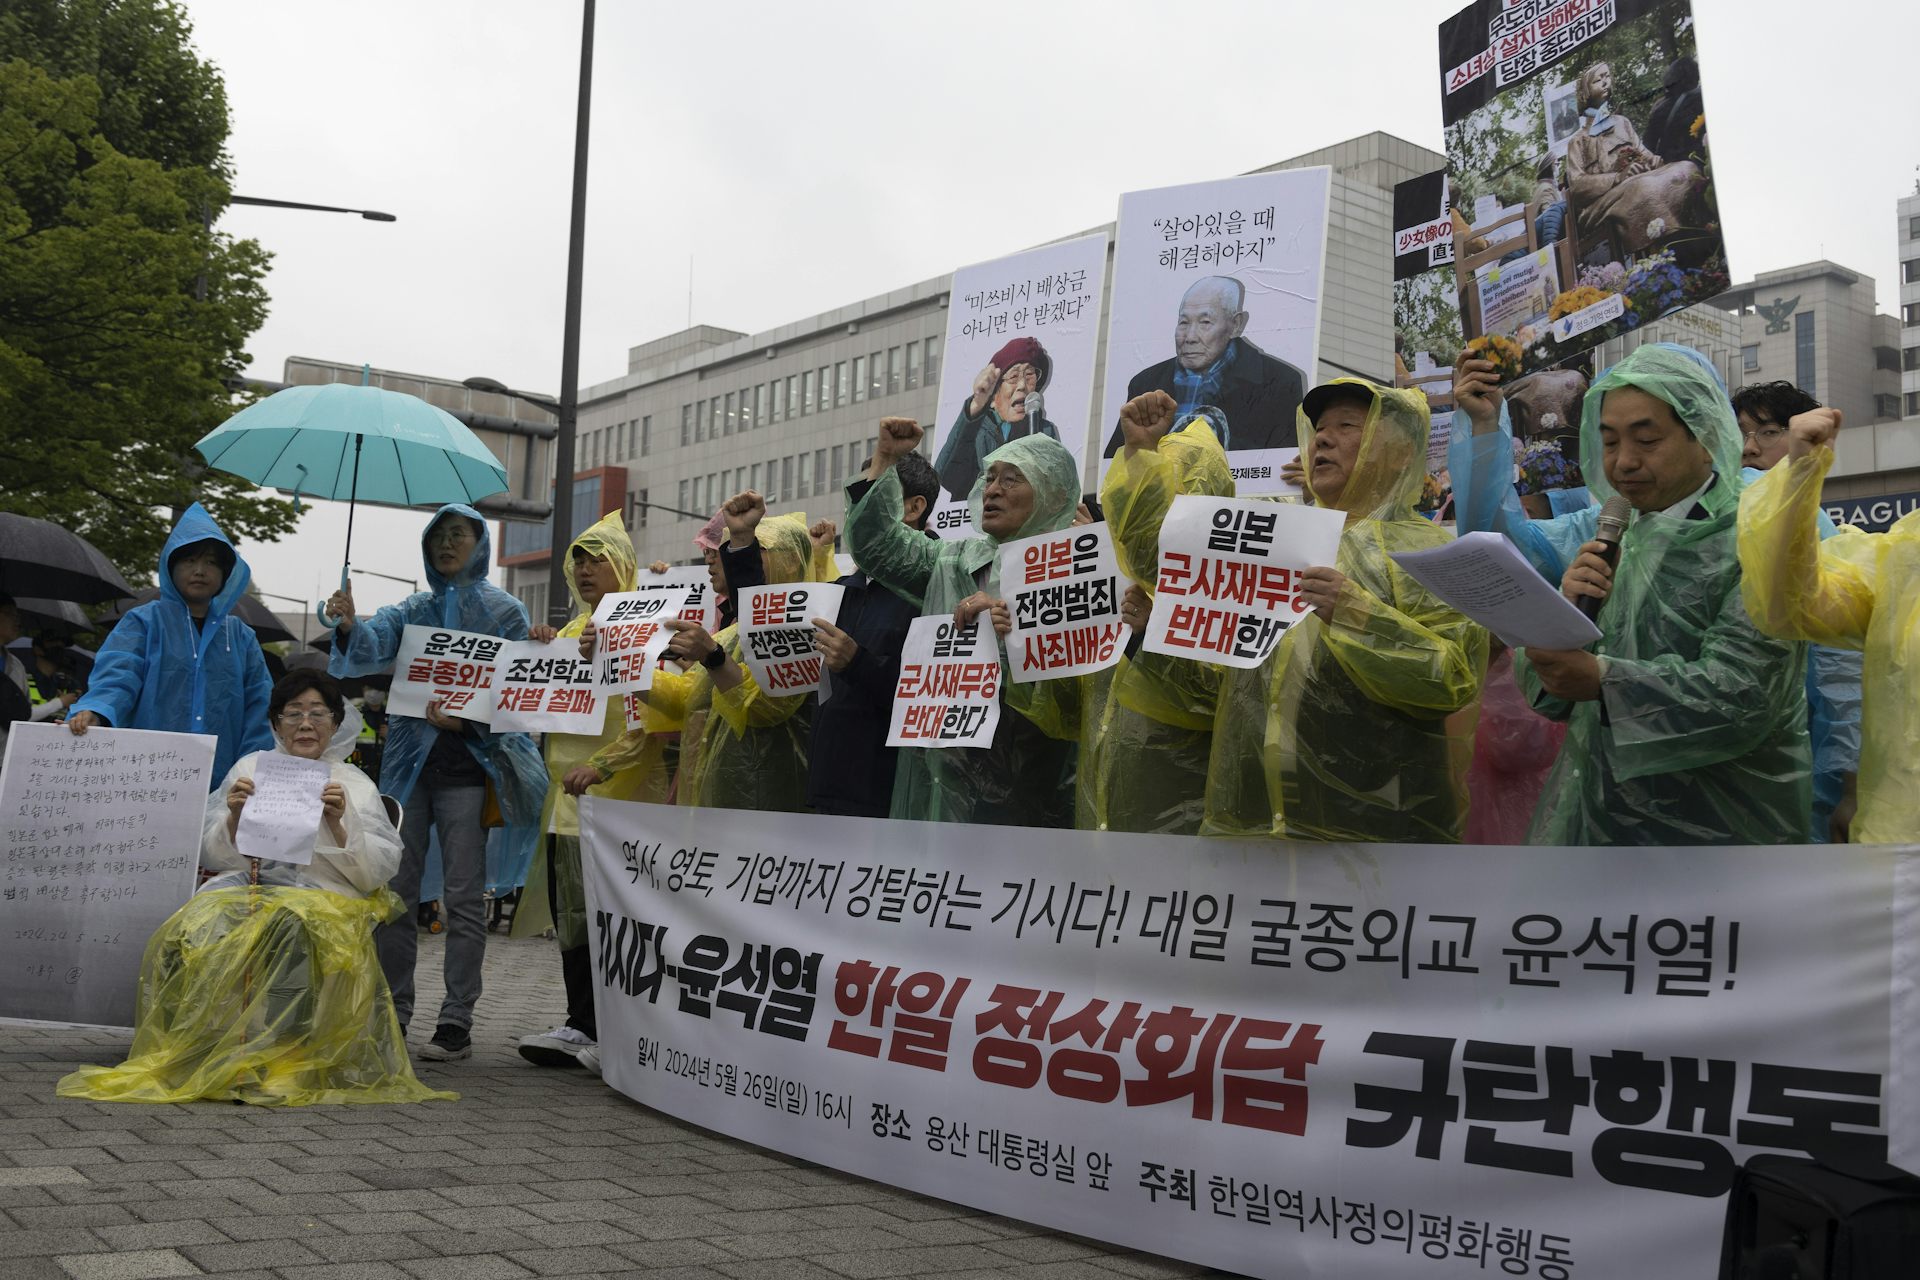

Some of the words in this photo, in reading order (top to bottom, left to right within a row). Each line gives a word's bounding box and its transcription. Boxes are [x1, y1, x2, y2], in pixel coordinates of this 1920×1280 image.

[1451, 45, 1497, 90] 소녀상
[1500, 25, 1536, 59] 설치
[1538, 0, 1606, 37] 방해외
[1500, 50, 1538, 83] 당장
[1539, 2, 1613, 63] 중단하라!
[1153, 209, 1246, 241] “살아있을
[1253, 206, 1275, 231] 때
[1399, 221, 1452, 251] 少女像の
[1159, 237, 1276, 271] 해결해야지”
[964, 280, 1031, 312] “미쓰비시
[1037, 270, 1087, 298] 배상금
[963, 311, 1008, 341] 아니면
[1013, 307, 1030, 330] 안
[1034, 295, 1091, 326] 받겠다”
[1230, 466, 1271, 480] 강제동원
[1208, 508, 1277, 557] 일본
[1024, 533, 1099, 584] 일본은
[607, 599, 667, 621] 일본의
[752, 590, 808, 626] 일본은
[1016, 576, 1117, 630] 전쟁범죄
[424, 632, 502, 662] 윤석열
[599, 623, 658, 653] 기업강탈
[933, 622, 979, 657] 일본
[1023, 621, 1122, 672] 사죄배상
[505, 658, 592, 684] 조선학교
[600, 652, 645, 686] 시도규탄
[897, 662, 1000, 699] 군사재무장
[497, 687, 545, 712] 차별
[547, 689, 596, 714] 철폐
[900, 705, 988, 739] 반대한다
[622, 840, 662, 890] 역사,
[667, 847, 719, 897] 영토,
[726, 853, 845, 913] 기업까지
[846, 864, 982, 931] 강탈하는
[991, 878, 1131, 949] 기시다!
[1139, 890, 1234, 962] 대일
[1251, 899, 1479, 979] 굴종외교
[1502, 913, 1740, 998] 윤석열!
[596, 910, 824, 1042] 기시다-윤석열
[827, 959, 972, 1072] 한일
[972, 983, 1325, 1137] 정상회담
[1346, 1031, 1888, 1198] 규탄행동
[638, 1037, 659, 1071] 일시
[665, 1048, 710, 1088] 2024년
[714, 1063, 738, 1096] 5월
[743, 1071, 808, 1116] 26일(일)
[815, 1090, 852, 1129] 16시
[871, 1102, 912, 1141] 장소
[925, 1115, 970, 1158] 용산
[977, 1127, 1075, 1184] 대통령실
[1086, 1151, 1113, 1192] 앞
[1139, 1161, 1197, 1211] 주최
[1208, 1174, 1575, 1280] 한일역사정의평화행동
